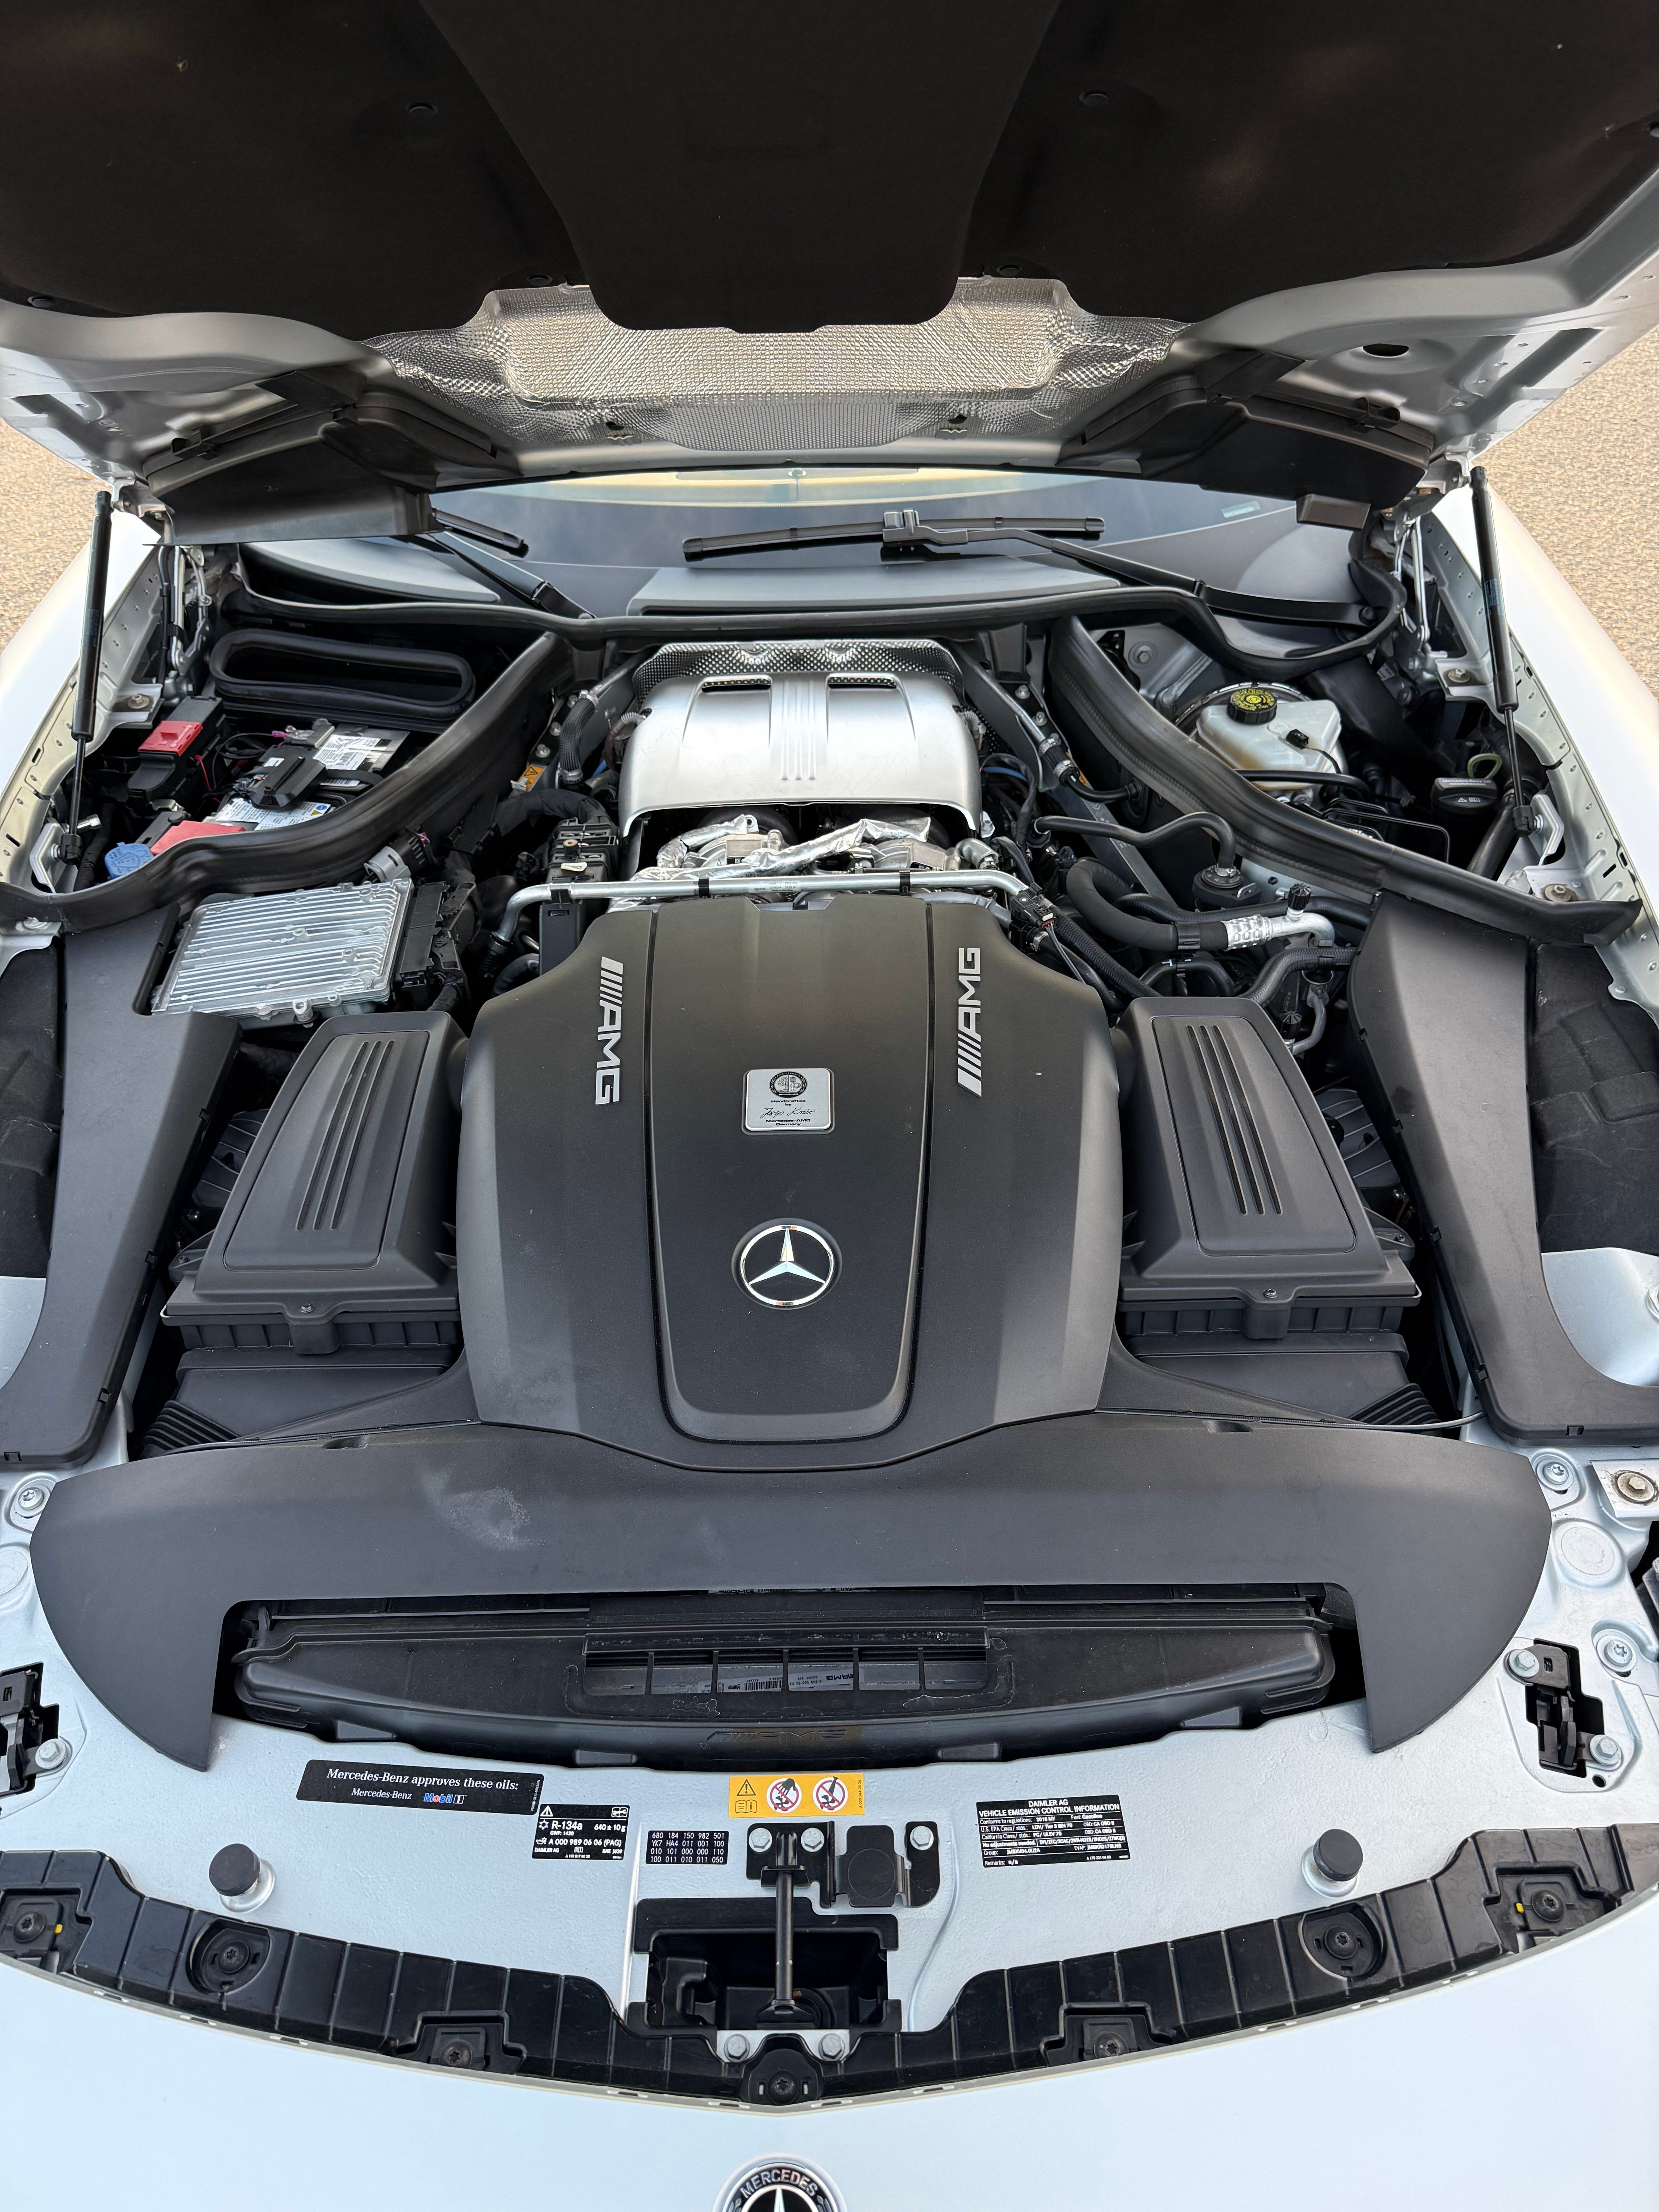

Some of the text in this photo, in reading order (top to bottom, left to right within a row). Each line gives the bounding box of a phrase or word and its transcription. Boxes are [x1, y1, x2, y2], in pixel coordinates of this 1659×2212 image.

[958, 948, 981, 1042] AMG
[595, 1000, 622, 1105] AMG
[326, 1769, 519, 1790] Mercedes-Benz approves these oils:
[351, 1788, 412, 1800] Mercedes-Benz
[423, 1793, 453, 1804] Mobil
[1074, 1803, 1120, 1812] INFORMATION
[551, 1820, 583, 1830] R-134a
[603, 1839, 622, 1847] (PAG)
[740, 2169, 819, 2198] MERCEDES
